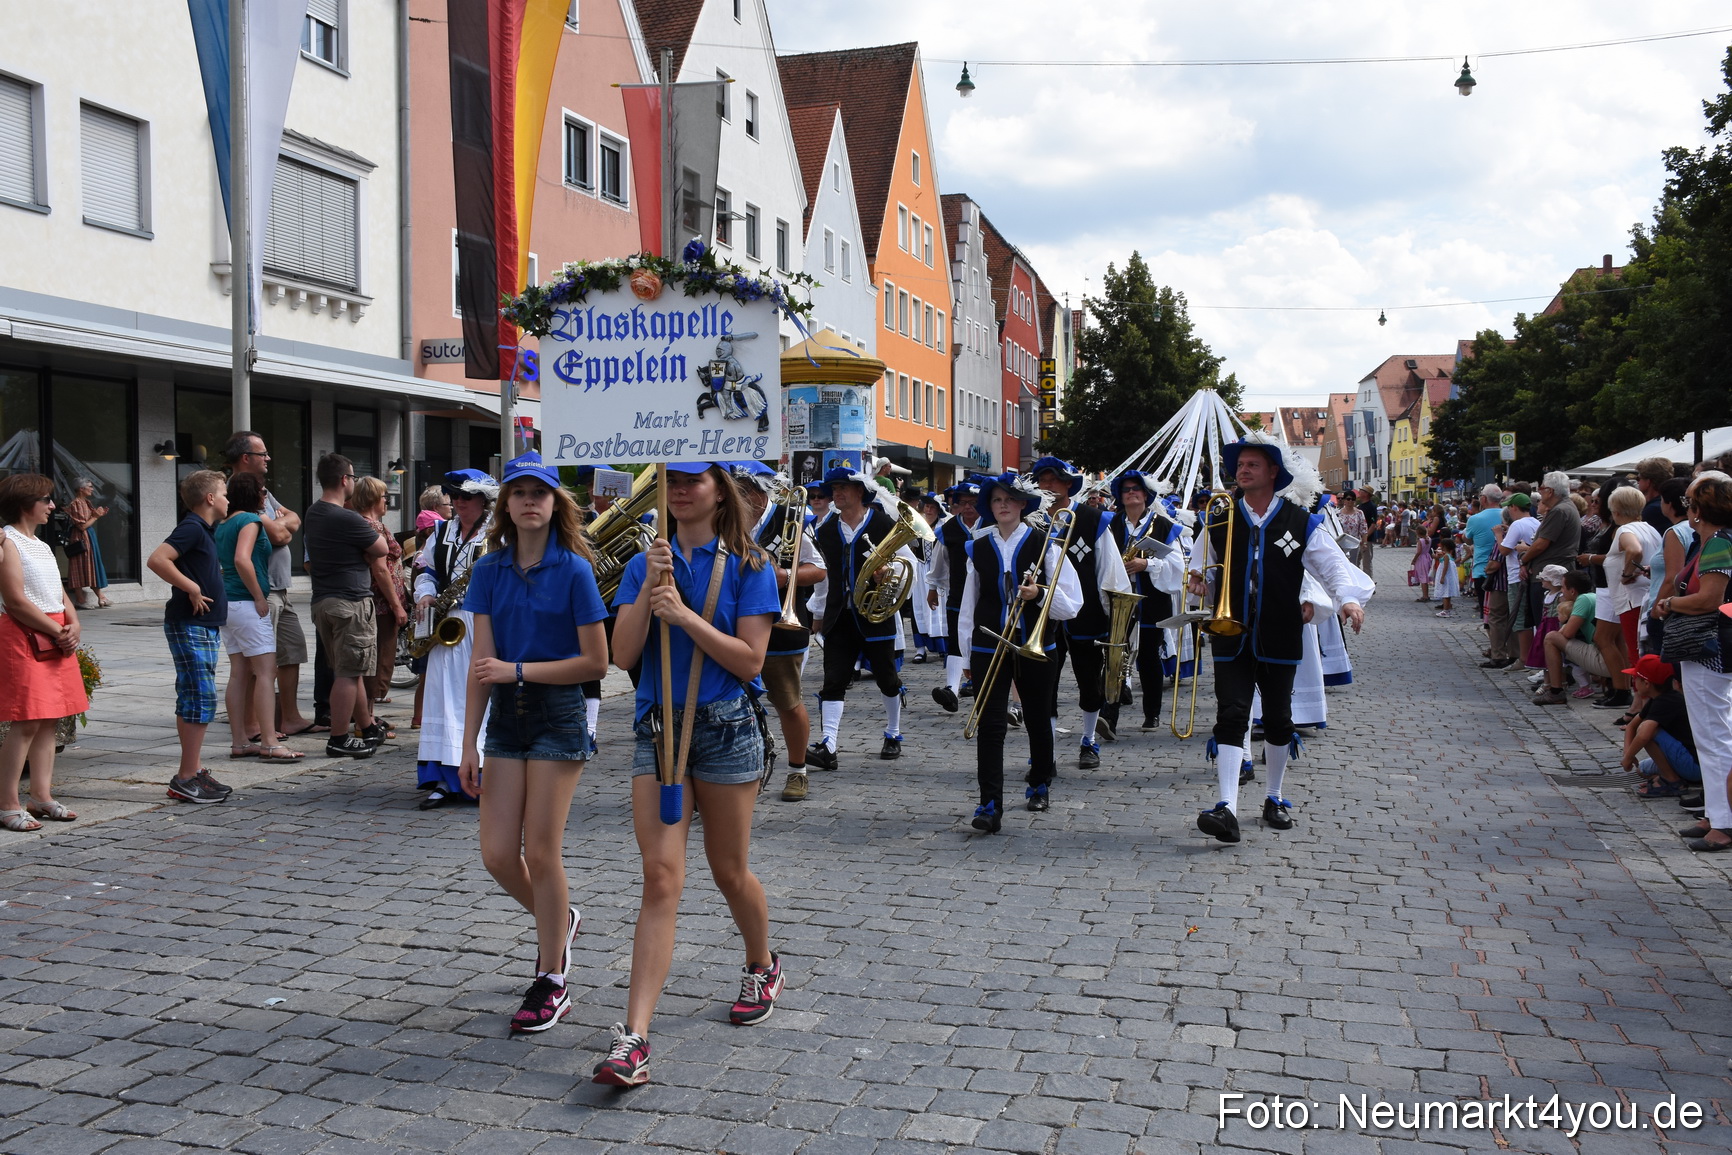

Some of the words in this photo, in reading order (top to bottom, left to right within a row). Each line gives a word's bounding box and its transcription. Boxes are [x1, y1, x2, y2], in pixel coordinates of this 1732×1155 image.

[551, 301, 734, 345] Blaskapelle
[523, 349, 539, 382] S
[553, 345, 688, 393] Eppelein
[633, 410, 690, 429] Markt
[554, 428, 769, 460] Postbauer-Heng
